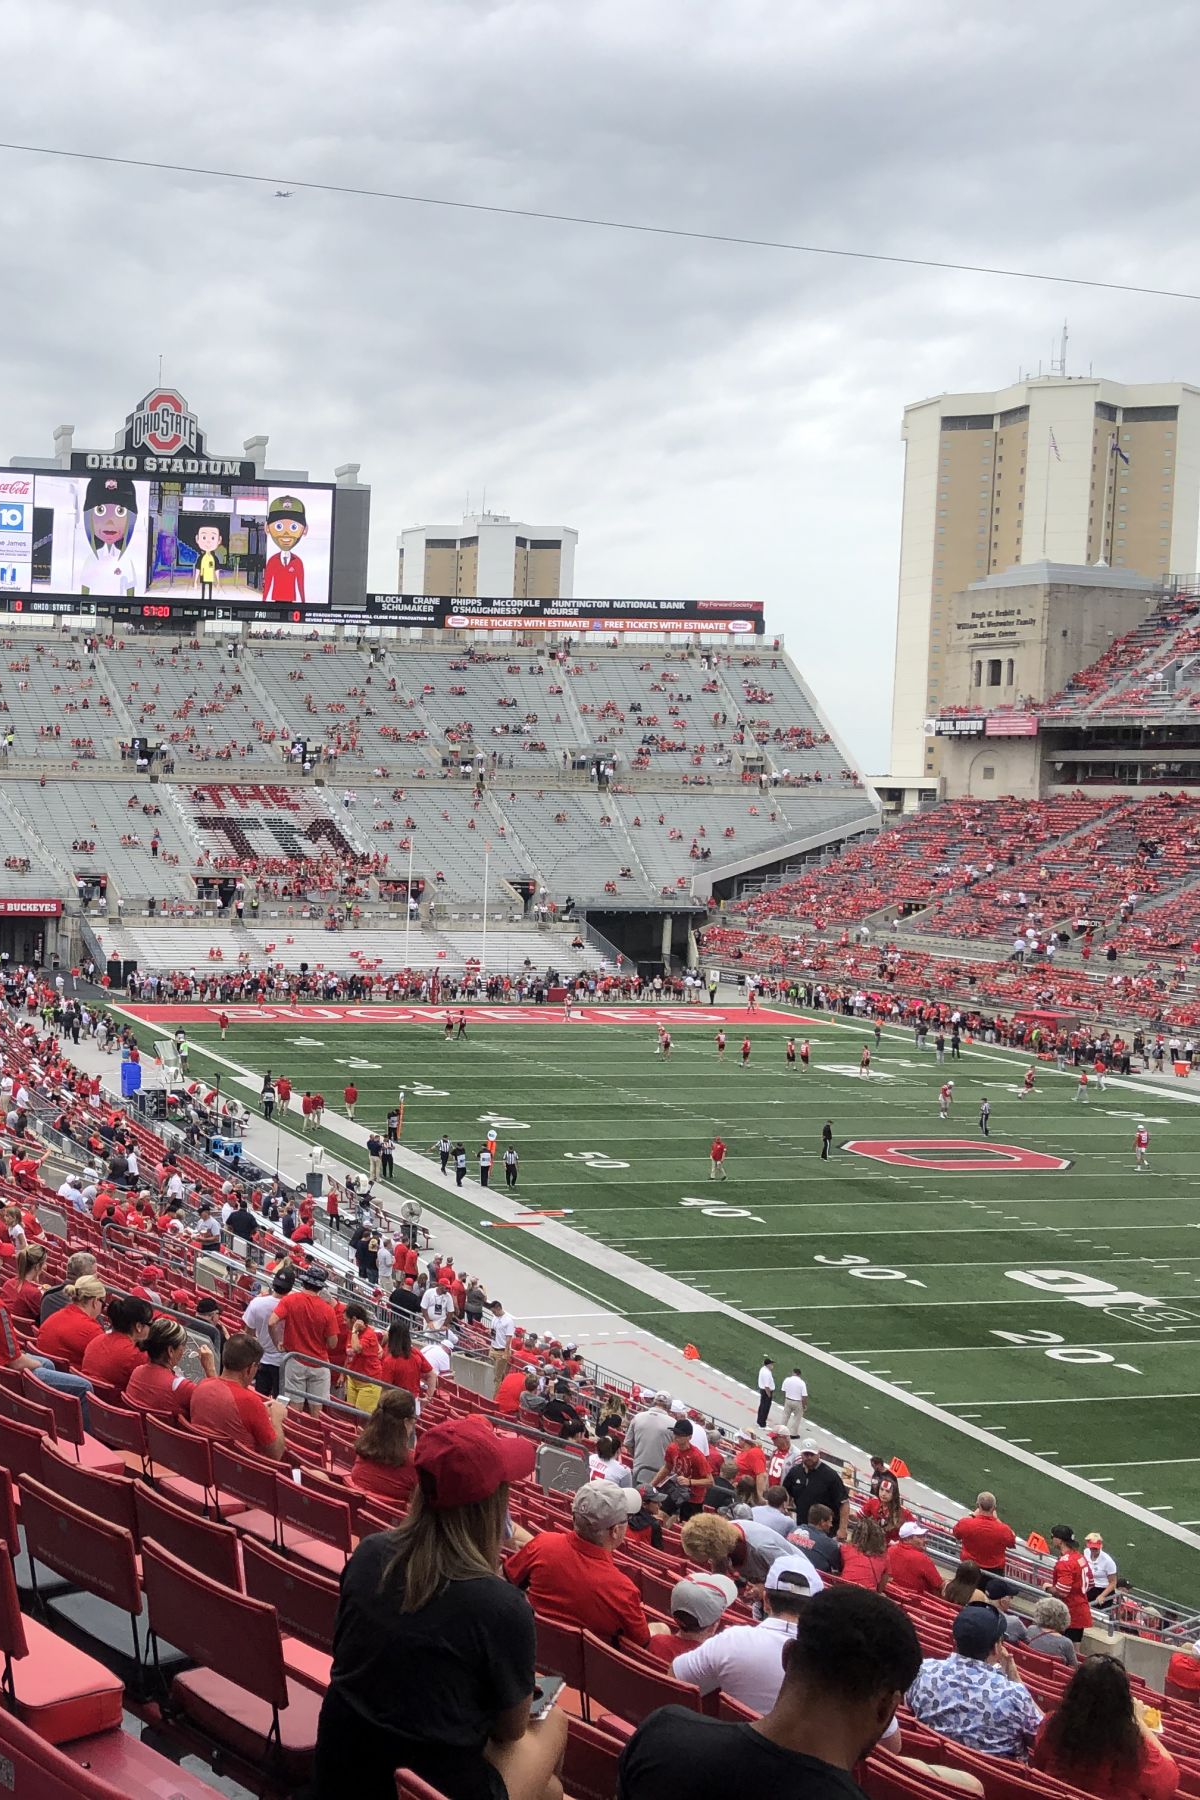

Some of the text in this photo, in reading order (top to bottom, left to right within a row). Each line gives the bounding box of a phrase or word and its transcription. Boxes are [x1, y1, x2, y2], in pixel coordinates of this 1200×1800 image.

[87, 454, 241, 477] OHIO STADIUM
[0, 509, 22, 526] 10
[375, 595, 402, 603] BLOCH
[413, 597, 440, 605] CRANE
[451, 598, 482, 607] PHIPPS
[493, 599, 540, 607] McCORKLE
[15, 601, 22, 612] 0
[33, 603, 49, 611] OHIO
[52, 604, 72, 612] STATE
[90, 604, 96, 613] 3
[381, 603, 434, 613] SCHUMAKER
[452, 606, 523, 615] O'SHAUGHNESSY
[552, 600, 685, 610] HUNTINGTON NATIONAL BANK
[143, 606, 170, 617] 57:20
[217, 608, 223, 618] 3
[255, 610, 267, 619] FAU
[293, 611, 300, 622] 0
[543, 607, 579, 616] NOURSE
[470, 618, 488, 627] FREE
[491, 619, 522, 627] TICKETS
[524, 620, 546, 628] WITH
[548, 620, 590, 628] ESTIMATE!
[604, 620, 624, 629] FREE
[626, 621, 658, 629] TICKETS
[660, 621, 682, 630] WITH
[684, 622, 726, 630] ESTIMATE!
[936, 720, 955, 731] PAUL
[956, 720, 983, 731] BROWN
[7, 903, 57, 912] BUCKEYES
[207, 1008, 727, 1022] BUCKEYES
[333, 1056, 382, 1069] 20
[398, 1081, 450, 1096] 30
[476, 1111, 532, 1129] 40
[564, 1151, 630, 1169] 50
[678, 1197, 752, 1218] 40
[814, 1254, 907, 1280] 30
[988, 1329, 1115, 1363] 20
[769, 1456, 785, 1478] 15
[892, 1458, 902, 1473] 10
